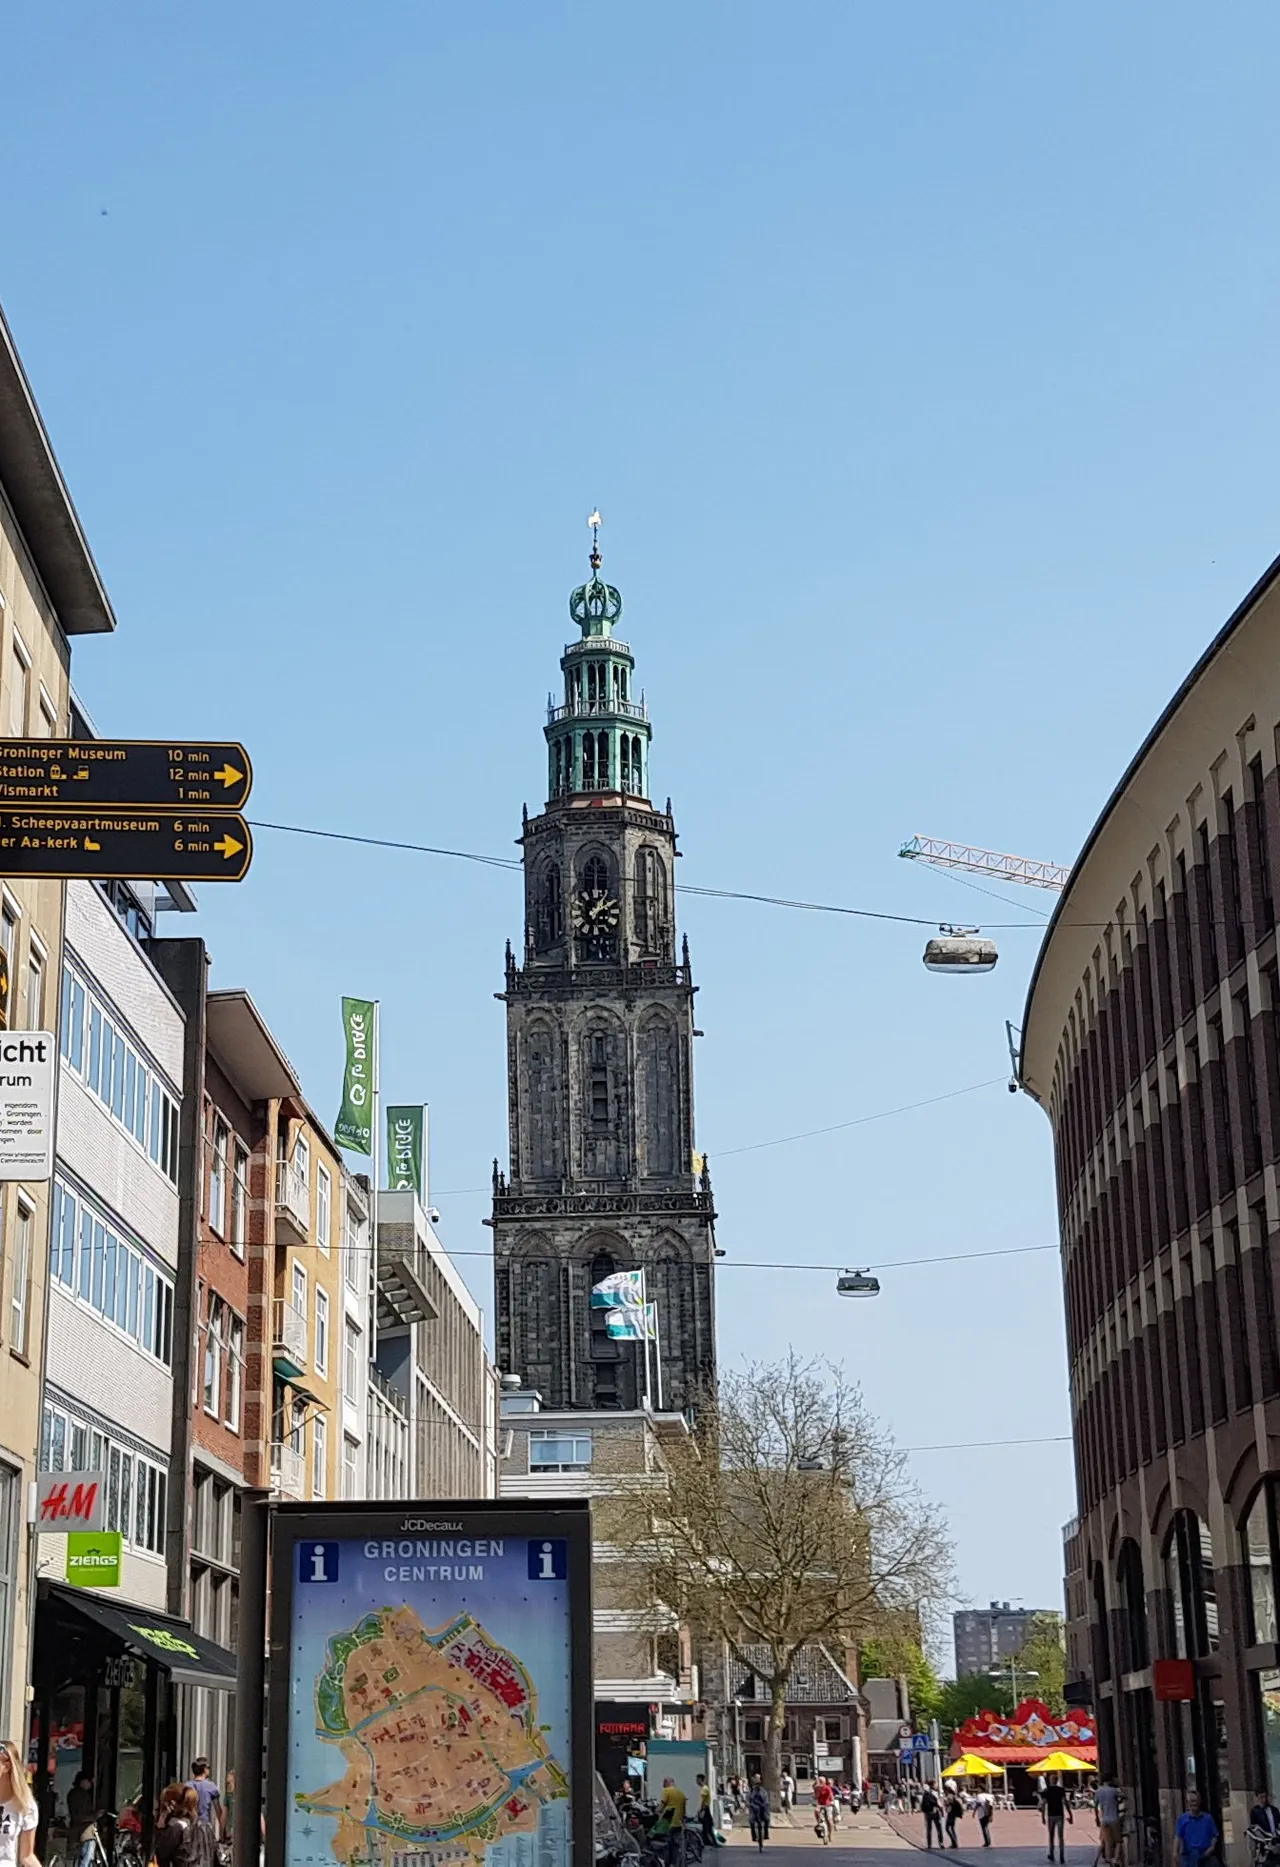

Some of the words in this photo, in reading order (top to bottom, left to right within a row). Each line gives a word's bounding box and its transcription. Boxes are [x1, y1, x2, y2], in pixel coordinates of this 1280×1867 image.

[68, 747, 126, 760] Museum
[168, 749, 183, 761] 10
[188, 750, 210, 762] min
[169, 768, 184, 780] 12
[188, 769, 210, 781] min
[177, 787, 184, 799] 1
[188, 788, 210, 799] min
[11, 816, 160, 834] Scheepvaartmuseum
[174, 820, 183, 832] 6
[188, 822, 210, 833] min
[20, 836, 78, 849] Aa-kerk
[174, 839, 183, 851] 6
[188, 840, 210, 851] min
[41, 1482, 97, 1521] H&M
[401, 1519, 463, 1531] JCDecaux
[364, 1540, 504, 1558] GRONINGEN
[384, 1565, 483, 1581] CENTRUM
